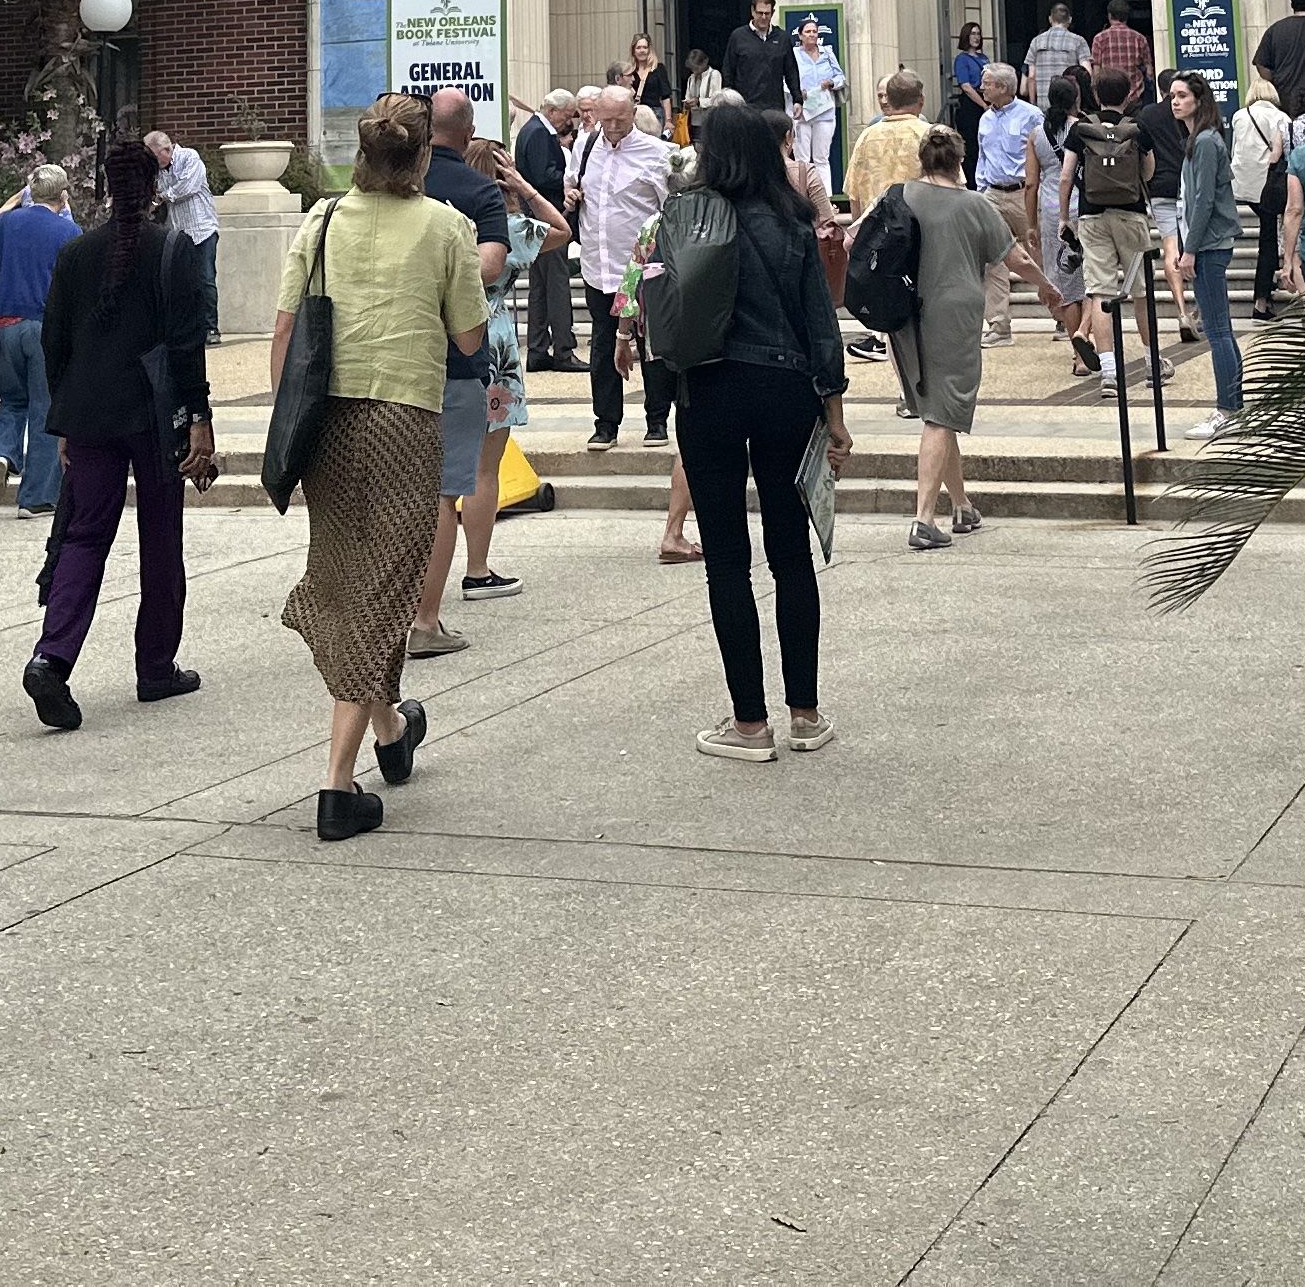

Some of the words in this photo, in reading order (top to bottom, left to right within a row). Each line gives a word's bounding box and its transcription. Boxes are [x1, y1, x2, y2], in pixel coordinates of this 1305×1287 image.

[407, 17, 437, 28] NEW
[438, 15, 497, 28] ORLEANS
[1192, 18, 1217, 28] NEW
[396, 28, 434, 40] BOOK
[436, 27, 497, 39] FESTIVAL
[1180, 26, 1228, 37] ORLEANS
[1189, 35, 1220, 45] BOOK
[1180, 43, 1230, 54] FESTIVAL
[408, 61, 484, 82] GENERAL
